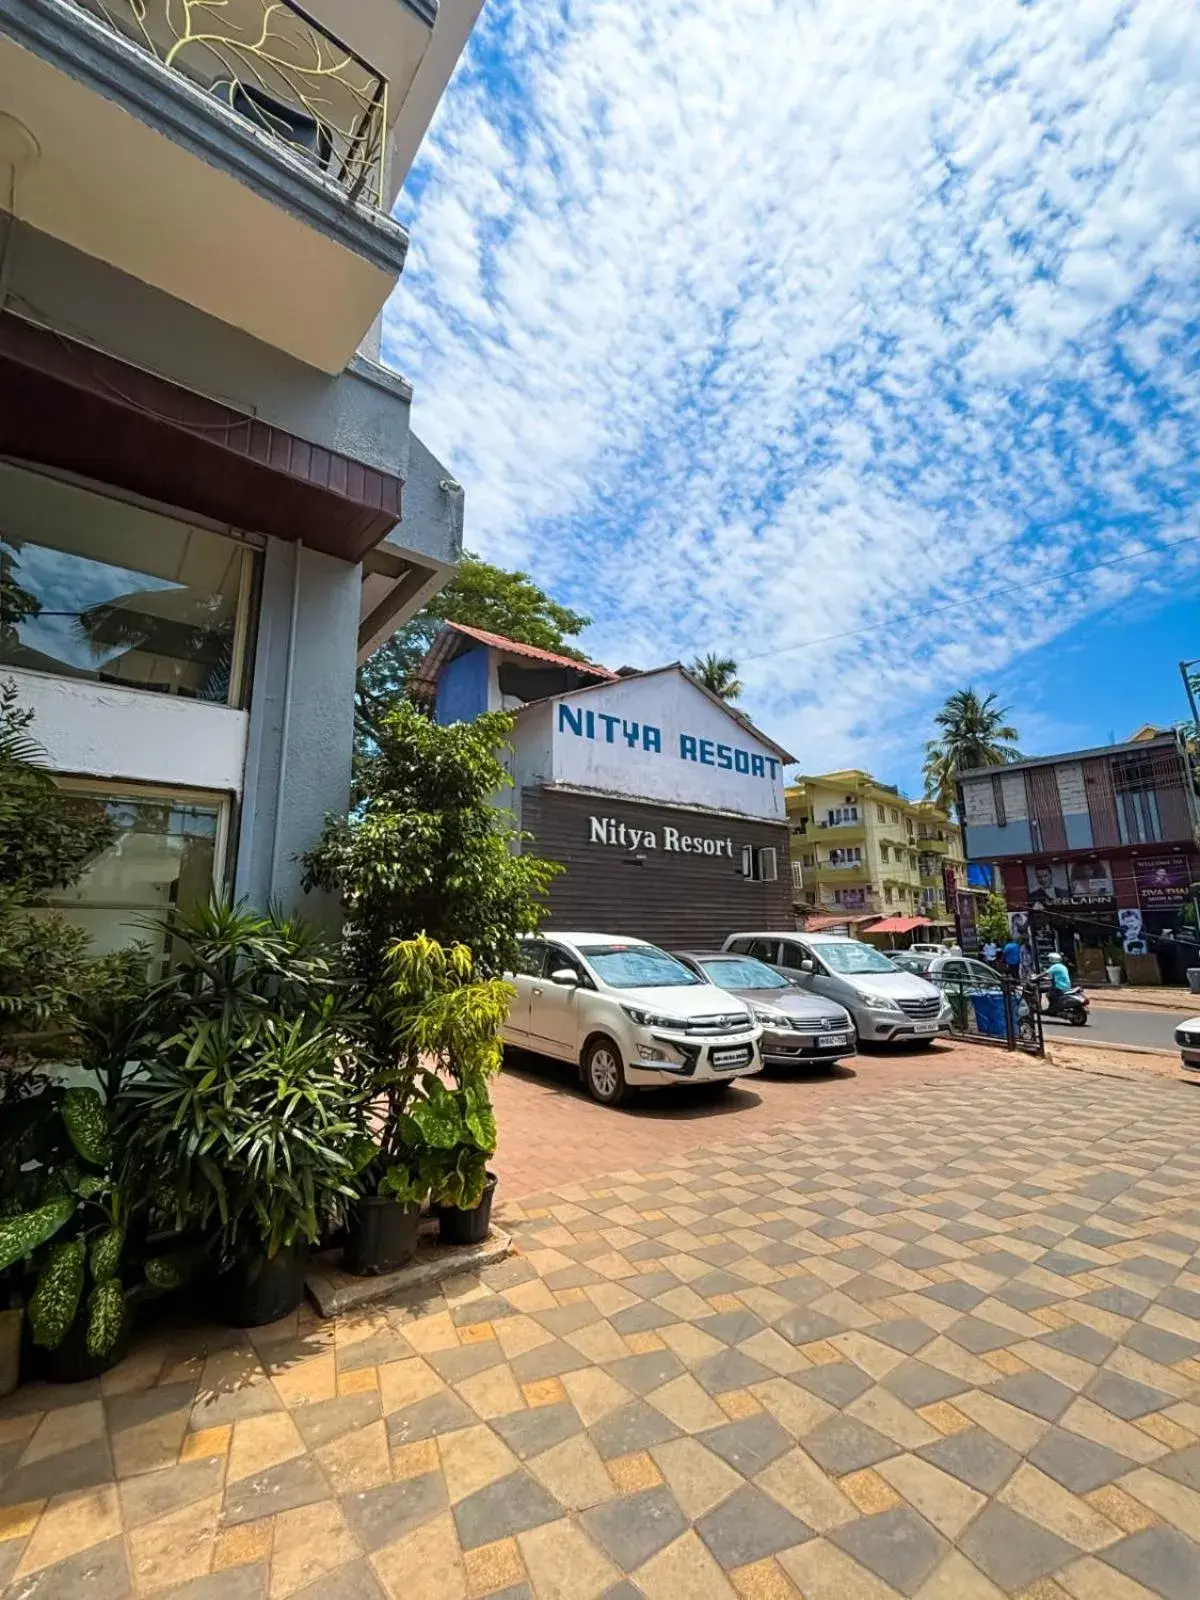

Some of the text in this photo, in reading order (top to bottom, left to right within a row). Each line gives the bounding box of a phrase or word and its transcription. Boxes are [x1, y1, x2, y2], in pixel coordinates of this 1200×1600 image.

[558, 703, 780, 780] NITYA RESORT
[588, 816, 733, 858] Nitya Resort
[1141, 887, 1189, 896] ZIVA THAI
